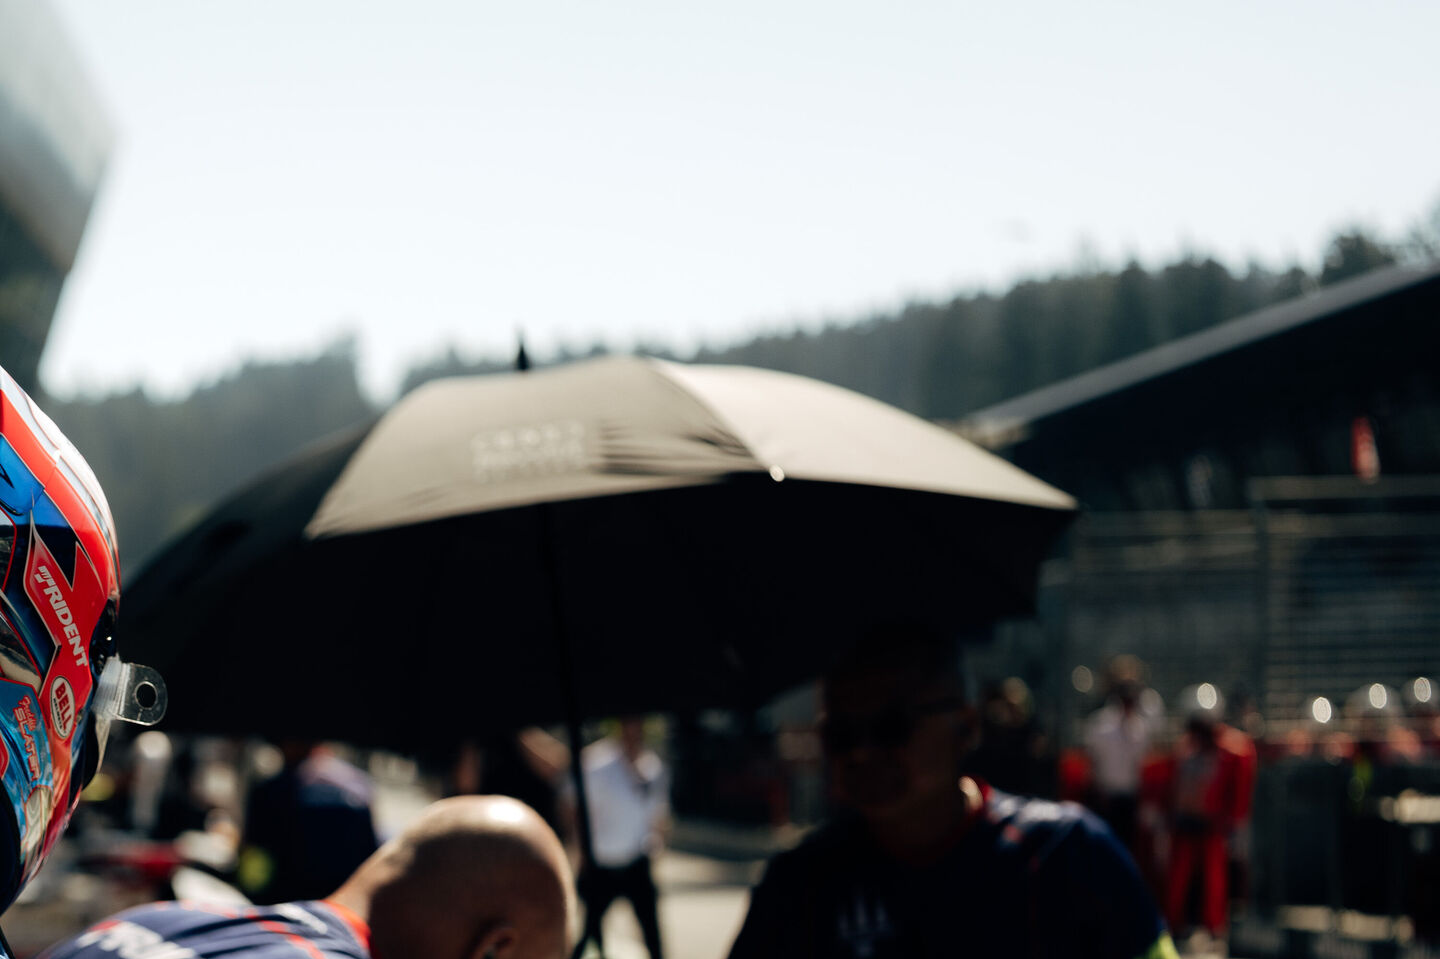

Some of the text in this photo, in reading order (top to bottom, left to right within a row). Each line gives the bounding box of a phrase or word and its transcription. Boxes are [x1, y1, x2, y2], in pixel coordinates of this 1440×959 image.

[34, 565, 88, 667] TRIDENT
[13, 707, 41, 782] SLATER
[55, 681, 73, 734] BELL
